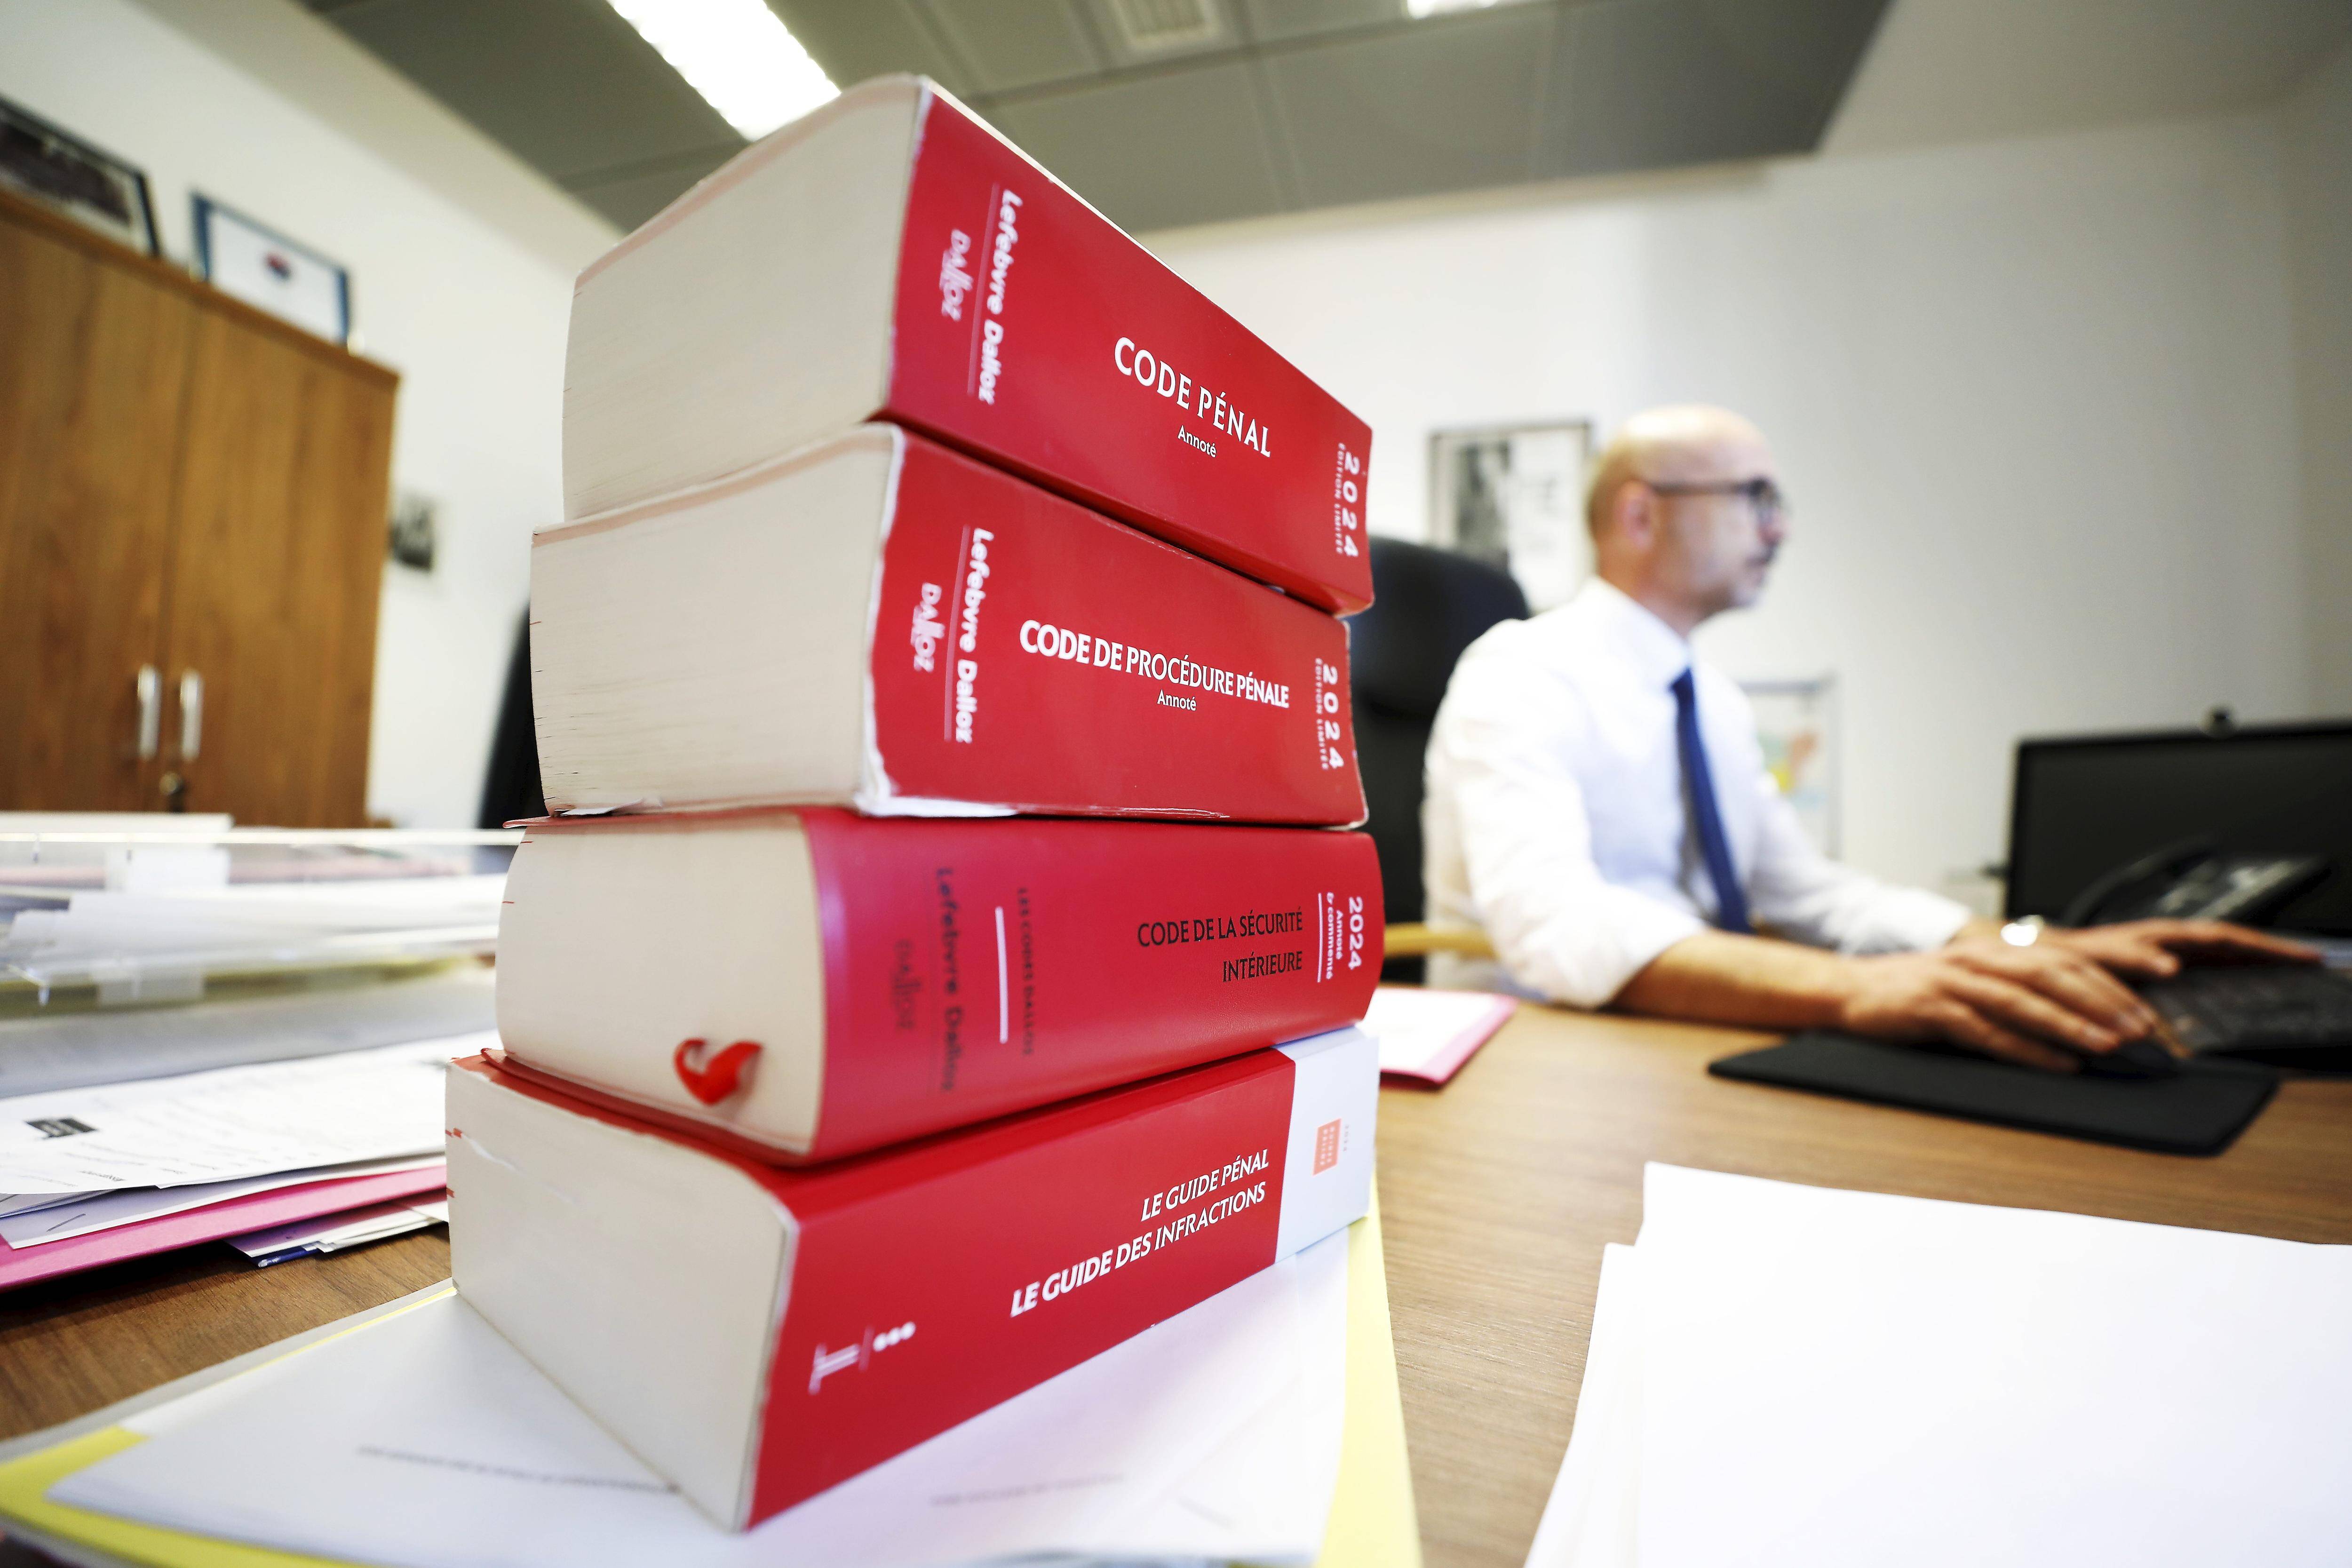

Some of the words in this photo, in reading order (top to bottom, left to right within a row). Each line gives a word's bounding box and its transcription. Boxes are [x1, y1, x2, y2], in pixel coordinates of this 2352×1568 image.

[987, 189, 1023, 315] Lefebvre
[978, 319, 1004, 405] Dalloz
[1114, 337, 1192, 410] CODE
[1197, 391, 1271, 458] PÉNAL
[1178, 425, 1216, 458] Annoté
[1344, 451, 1360, 557] 2024
[959, 527, 994, 653] Lefebvre
[956, 659, 978, 743] Dalloz
[1019, 619, 1090, 664] CODE
[1093, 637, 1123, 671] DE
[1125, 654, 1234, 696] PROCÉDURE
[1236, 671, 1289, 708] PÉNALE
[1157, 689, 1196, 711] Annoté
[1323, 664, 1344, 769] 2024
[1137, 920, 1189, 947] CODE
[1193, 918, 1215, 941] DE
[1218, 916, 1237, 939] LA
[1240, 906, 1303, 935] SÉCURITÉ
[1223, 951, 1303, 982] INTÉRIEURE
[1348, 896, 1364, 970] 2024
[1141, 1193, 1164, 1222] LE
[1165, 1169, 1219, 1210] GUIDE
[1221, 1148, 1269, 1186] PÉNAL
[1010, 1281, 1040, 1317] LE
[1042, 1249, 1113, 1301] GUIDE
[1115, 1231, 1152, 1269] DES
[1154, 1181, 1266, 1250] INFRACTIONS
